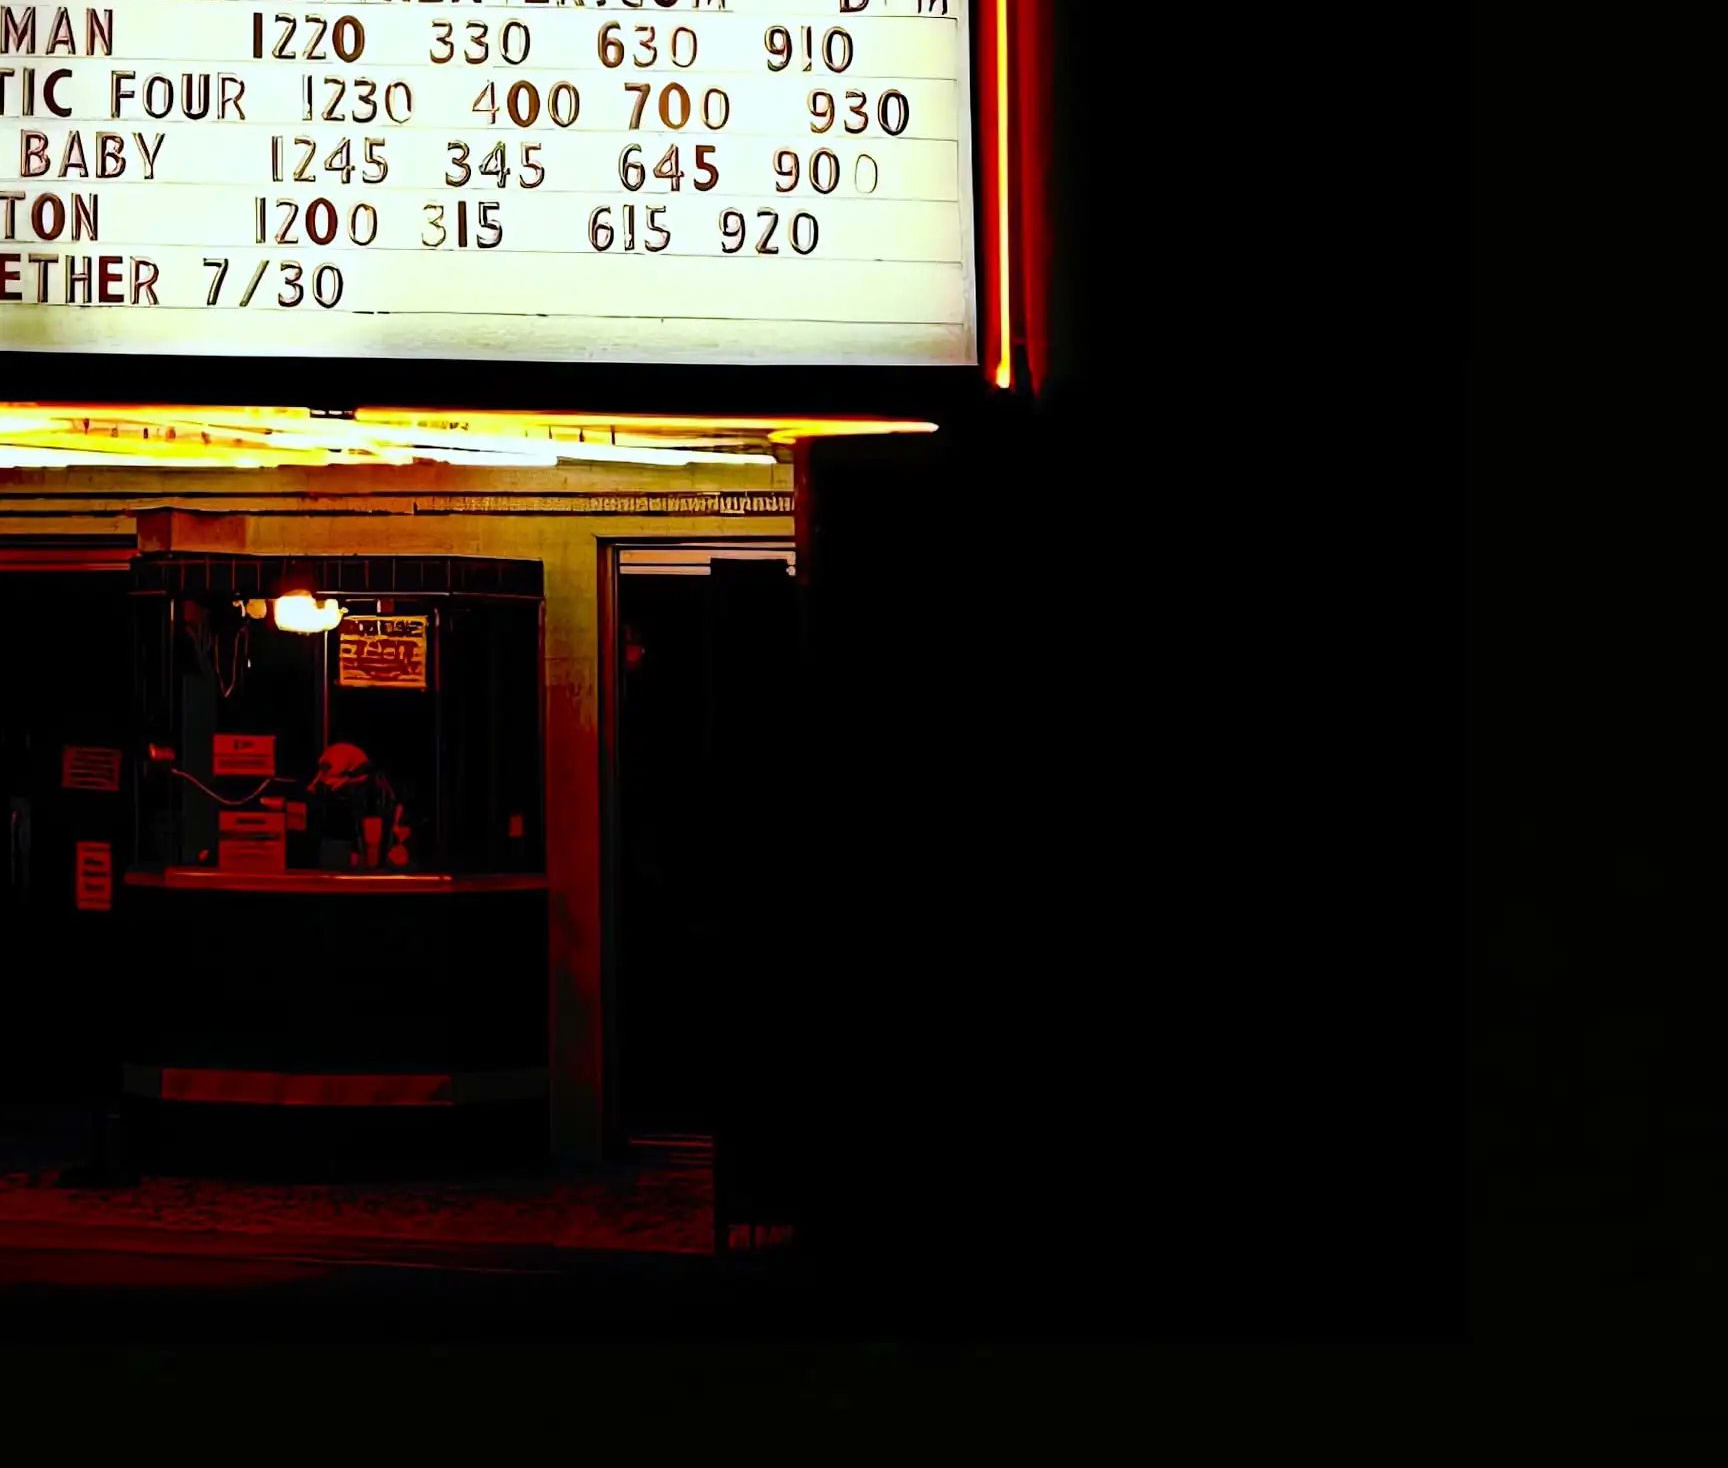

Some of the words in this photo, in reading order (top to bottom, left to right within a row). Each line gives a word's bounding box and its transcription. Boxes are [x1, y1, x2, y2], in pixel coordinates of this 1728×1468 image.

[253, 13, 365, 63] 1220
[430, 19, 531, 65] 330
[598, 21, 698, 68] 630
[765, 25, 854, 73] 910
[110, 70, 247, 121] FOUR
[302, 76, 413, 124] 1230
[472, 80, 580, 128] 400
[624, 82, 730, 130] 700
[808, 89, 910, 136] 930
[20, 129, 166, 180] BABY
[271, 135, 388, 184] 1245
[446, 140, 545, 188] 345
[618, 144, 720, 192] 645
[773, 146, 878, 195] 900
[255, 197, 378, 247] 1200
[422, 201, 504, 249] 315
[588, 204, 672, 253] 615
[718, 208, 820, 255] 920
[203, 258, 344, 309] 7/30
